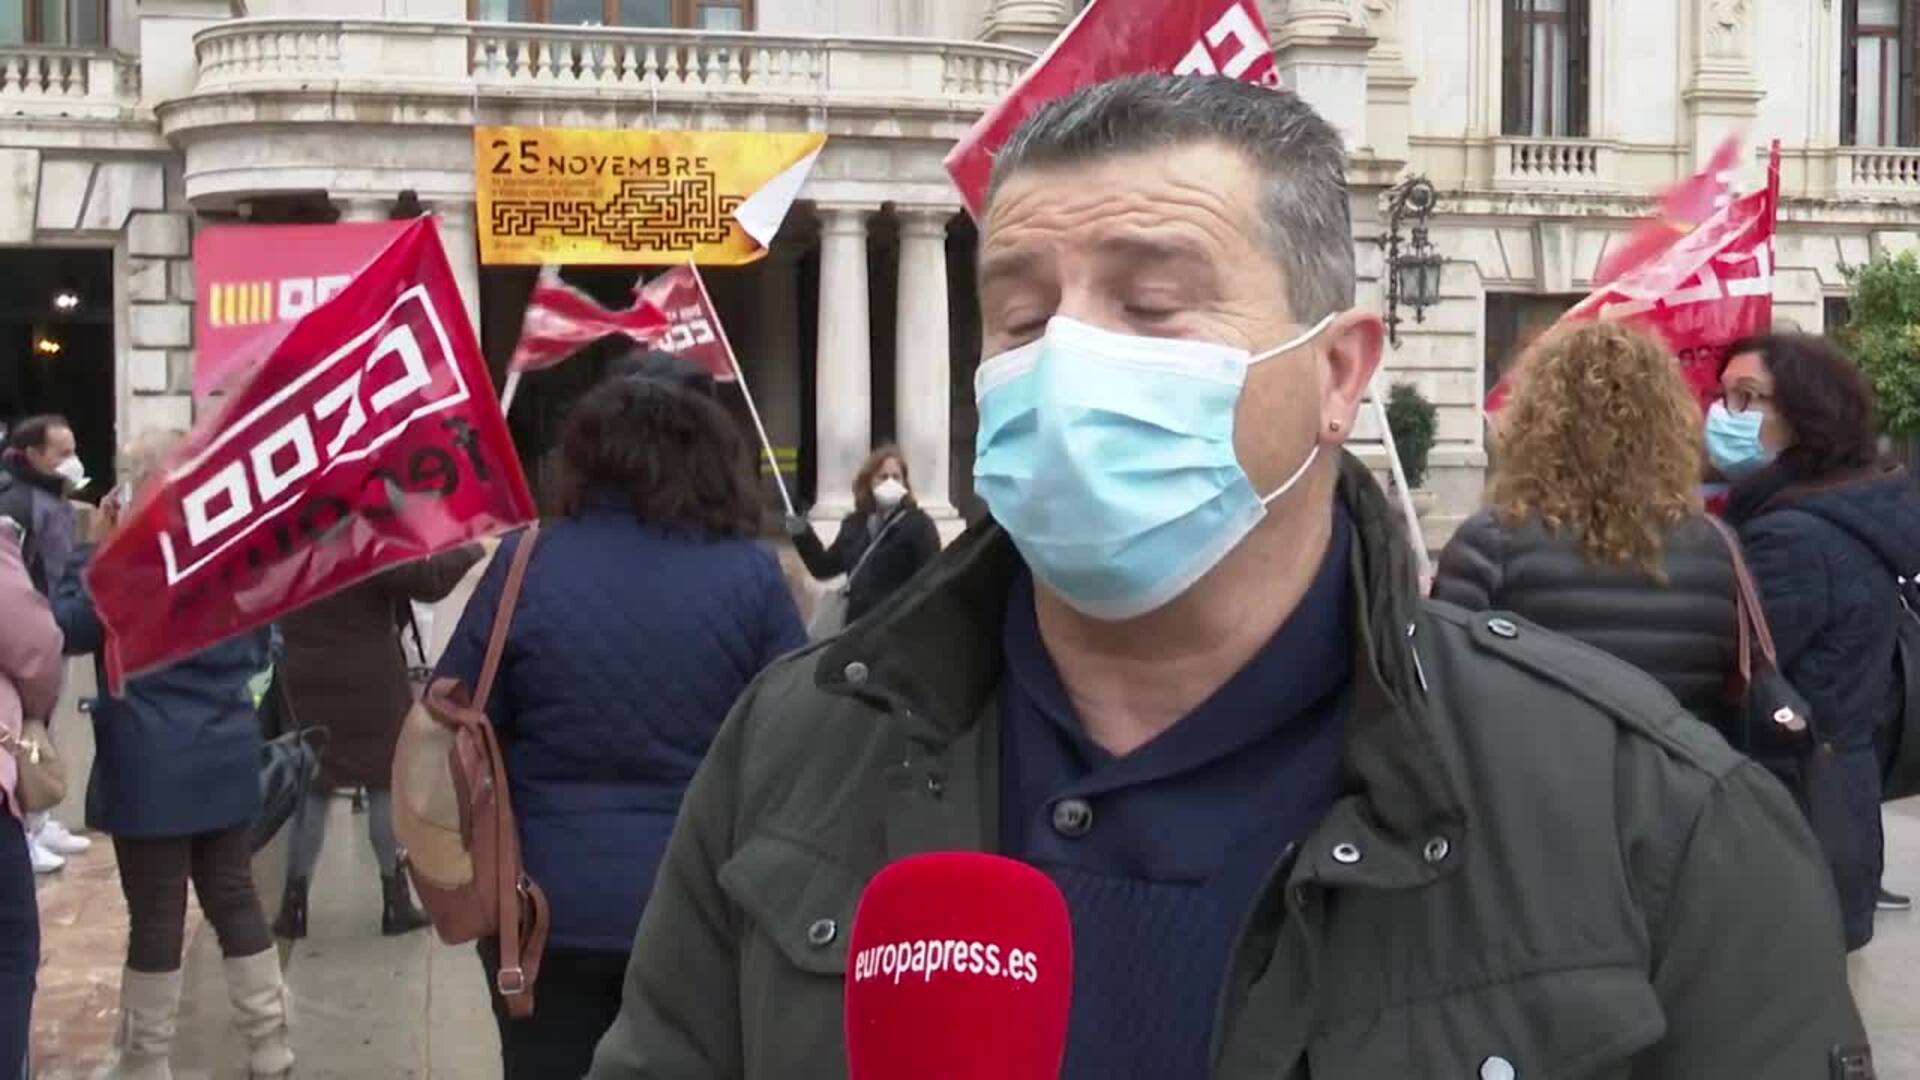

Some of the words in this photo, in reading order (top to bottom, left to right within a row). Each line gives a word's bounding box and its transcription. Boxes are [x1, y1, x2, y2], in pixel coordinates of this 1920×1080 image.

[491, 140, 541, 174] 25
[548, 156, 709, 176] NOVEMBRE
[855, 939, 1038, 984] europapress.es
